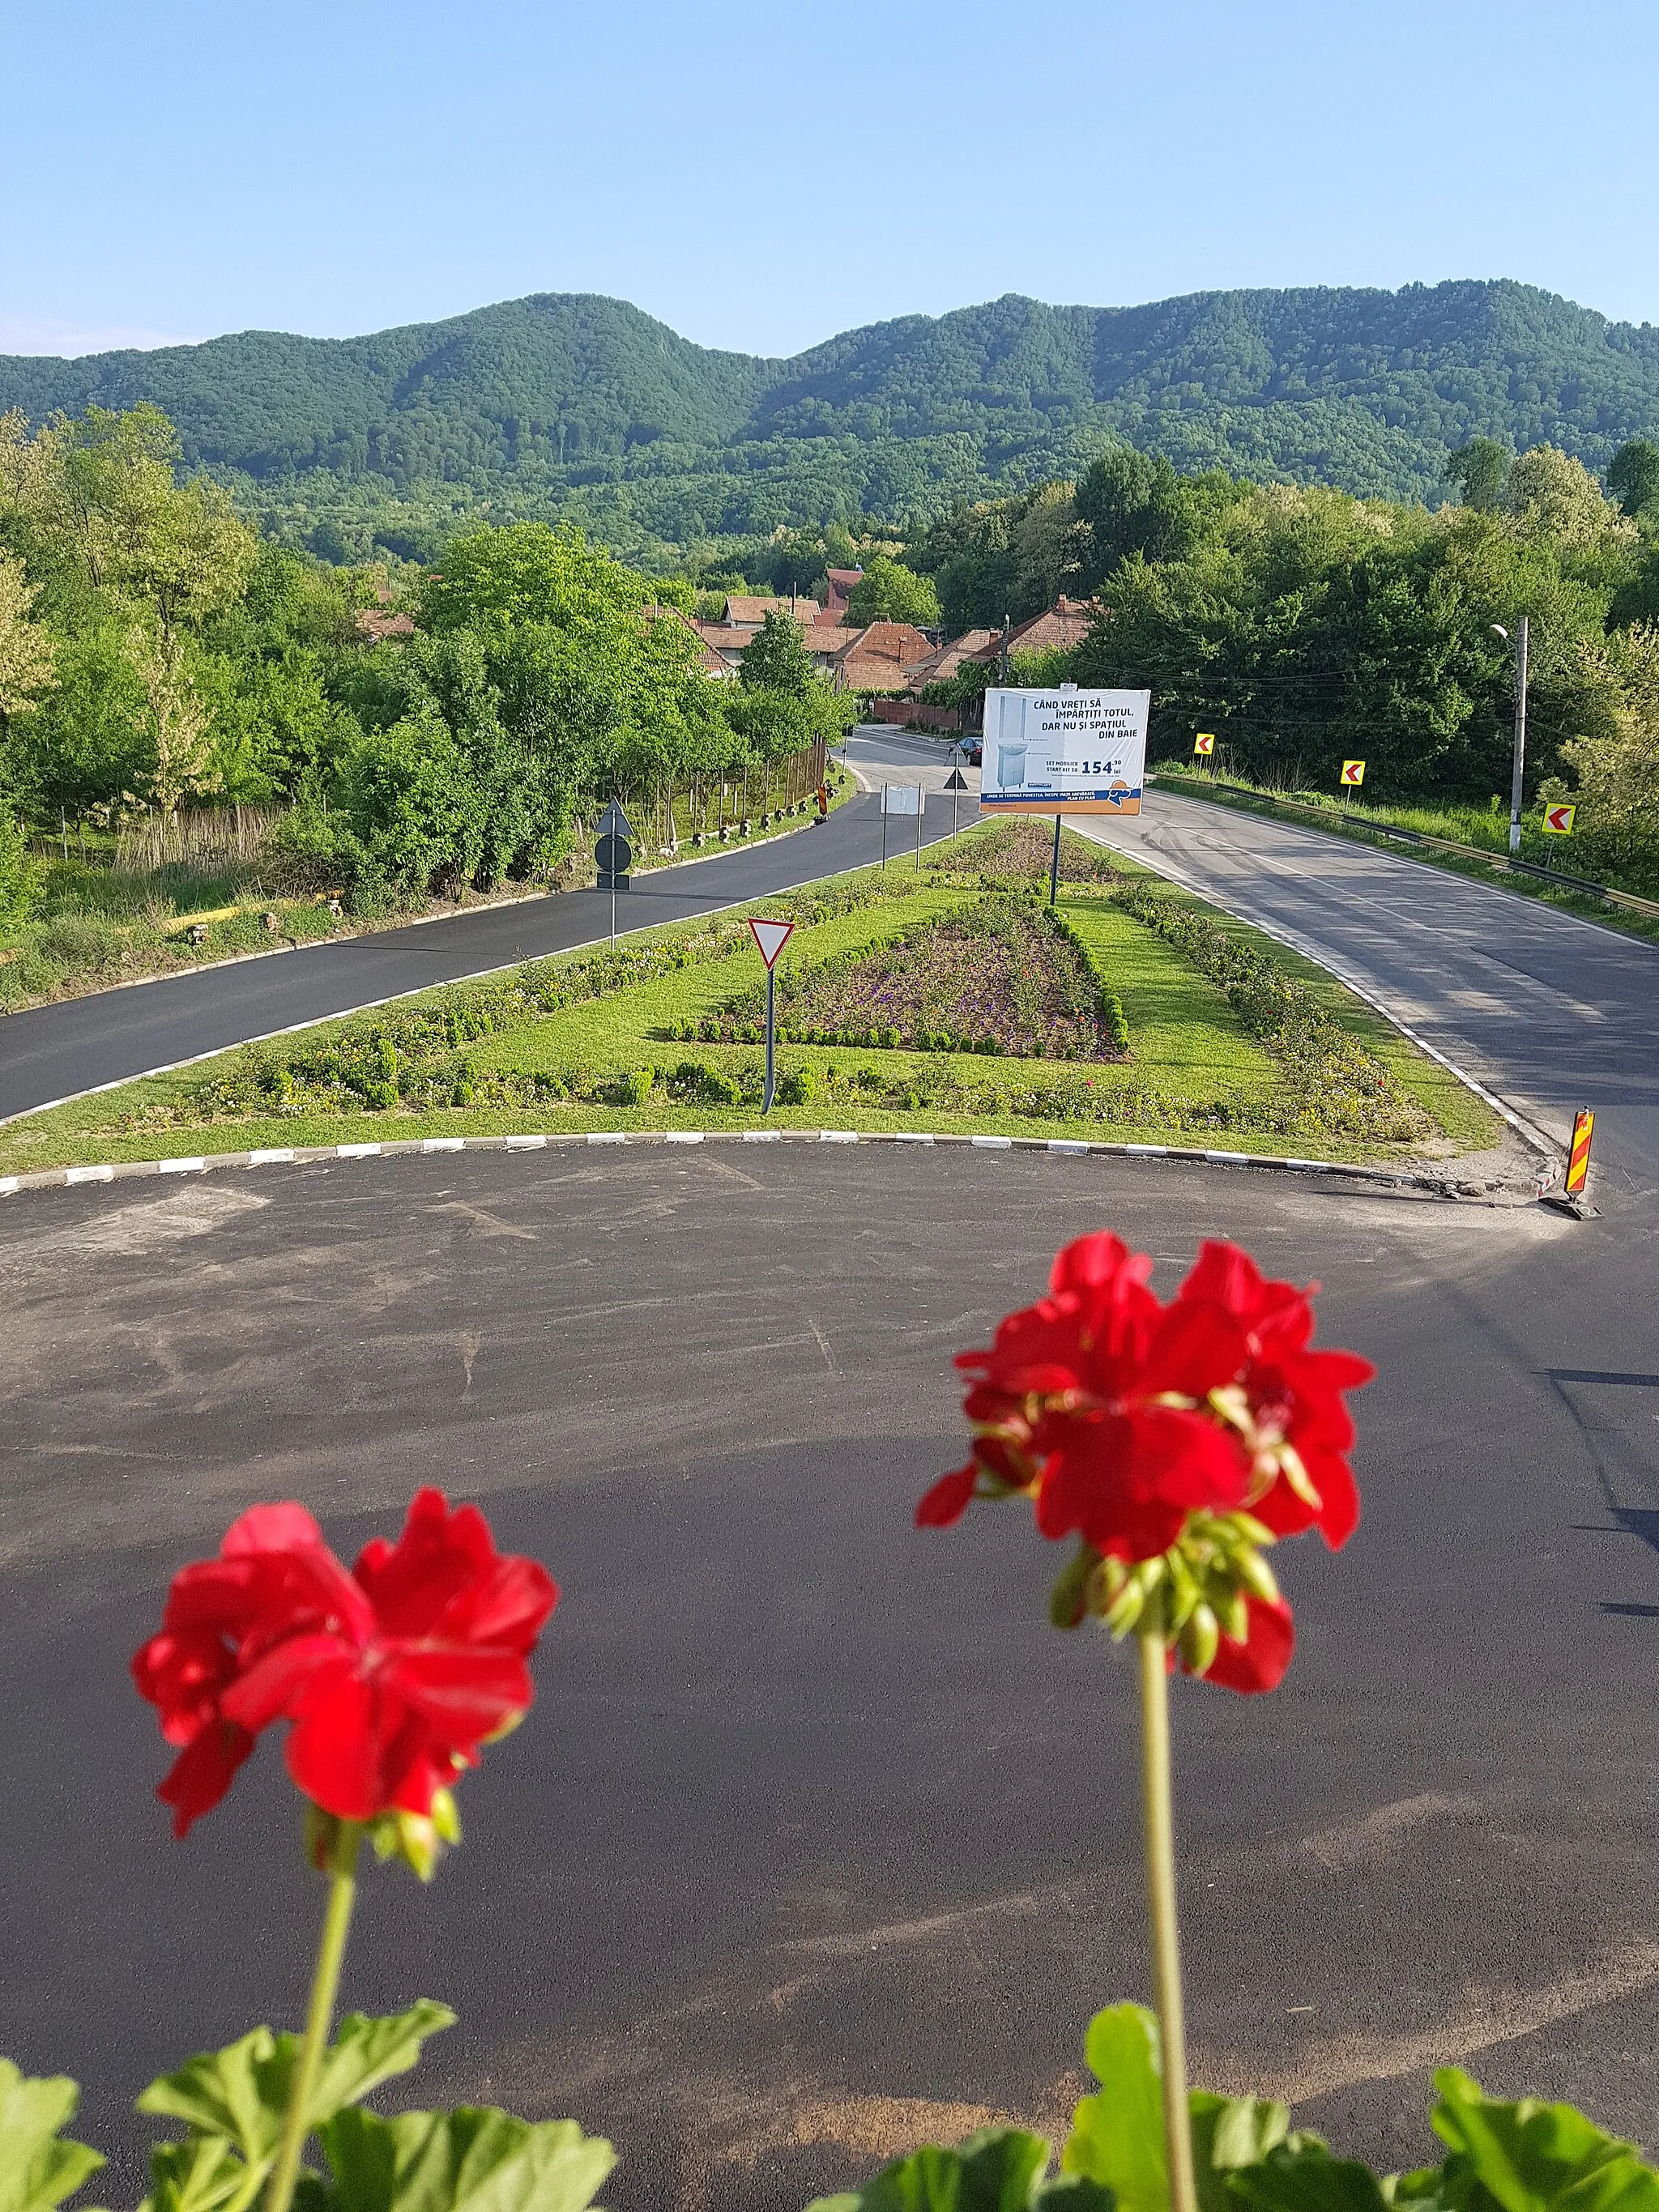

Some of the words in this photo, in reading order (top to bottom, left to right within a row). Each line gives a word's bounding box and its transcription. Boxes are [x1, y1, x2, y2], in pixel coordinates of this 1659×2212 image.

[1034, 699, 1058, 710] CÂND
[1061, 700, 1087, 710] VREȚI
[1090, 697, 1102, 708] SĂ
[1056, 709, 1101, 719] ÎMPĂRȚIȚI
[1103, 708, 1134, 718] TOTUL,
[1042, 722, 1060, 731] DAR
[1063, 722, 1077, 731] NU
[1079, 721, 1087, 731] ȘI
[1090, 720, 1127, 730] SPAȚIUL
[1098, 731, 1115, 739] DIN
[1117, 729, 1138, 738] BAIE
[1081, 761, 1112, 774] 154
